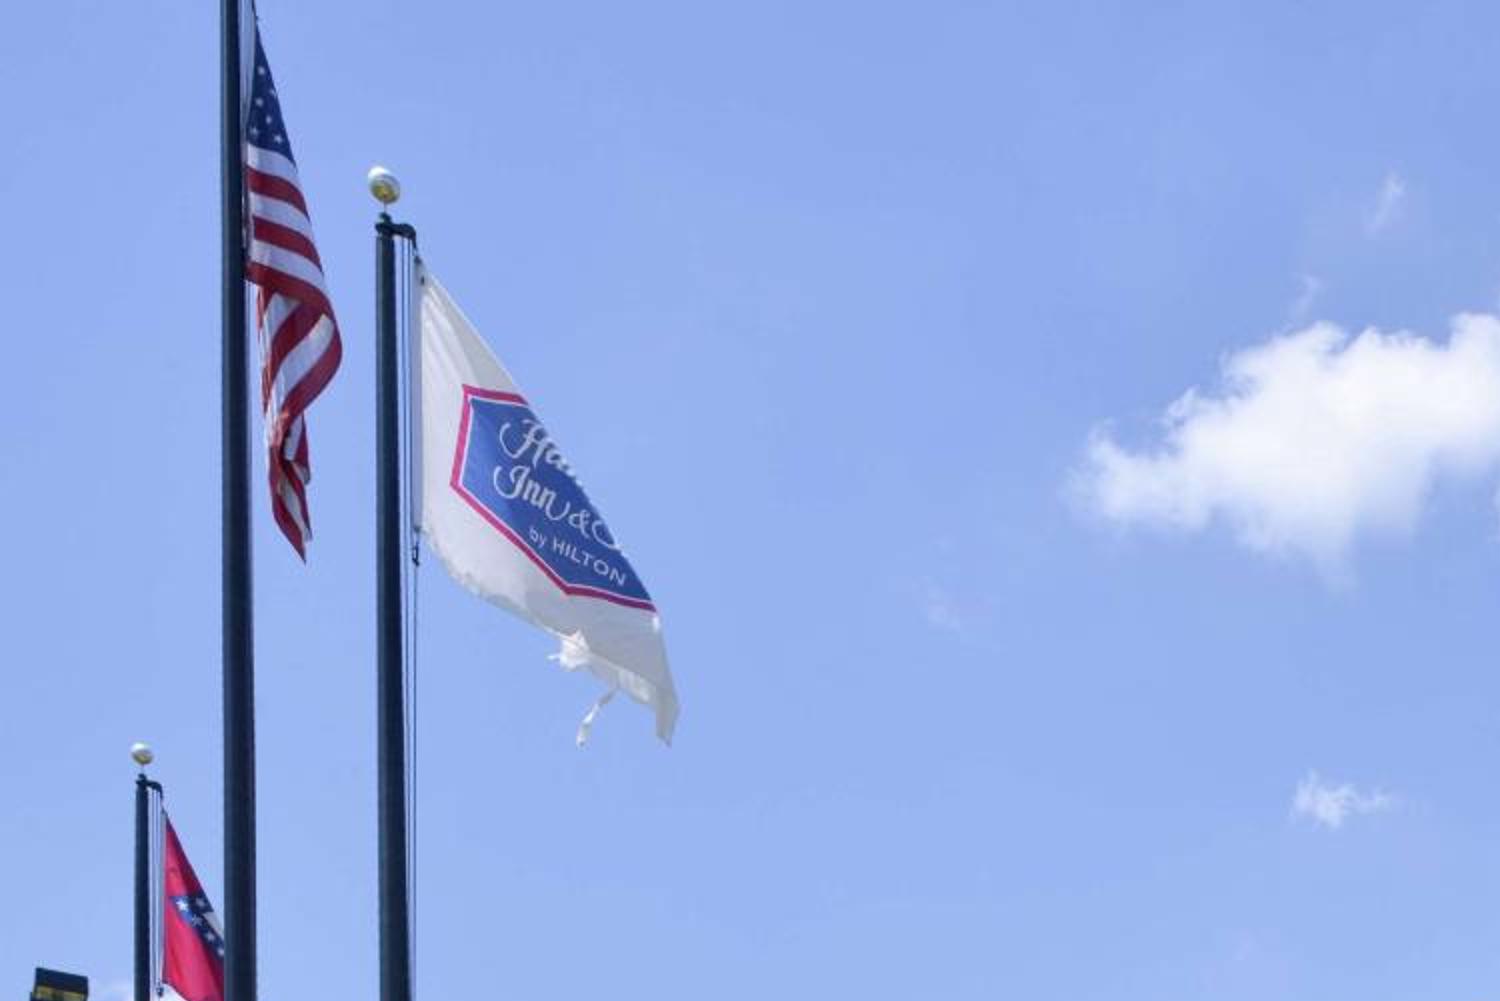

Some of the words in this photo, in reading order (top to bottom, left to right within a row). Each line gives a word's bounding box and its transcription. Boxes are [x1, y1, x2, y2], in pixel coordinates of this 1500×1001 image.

[493, 465, 571, 521] Inn
[568, 509, 591, 539] &
[528, 527, 547, 549] by
[552, 536, 627, 586] HILTON
